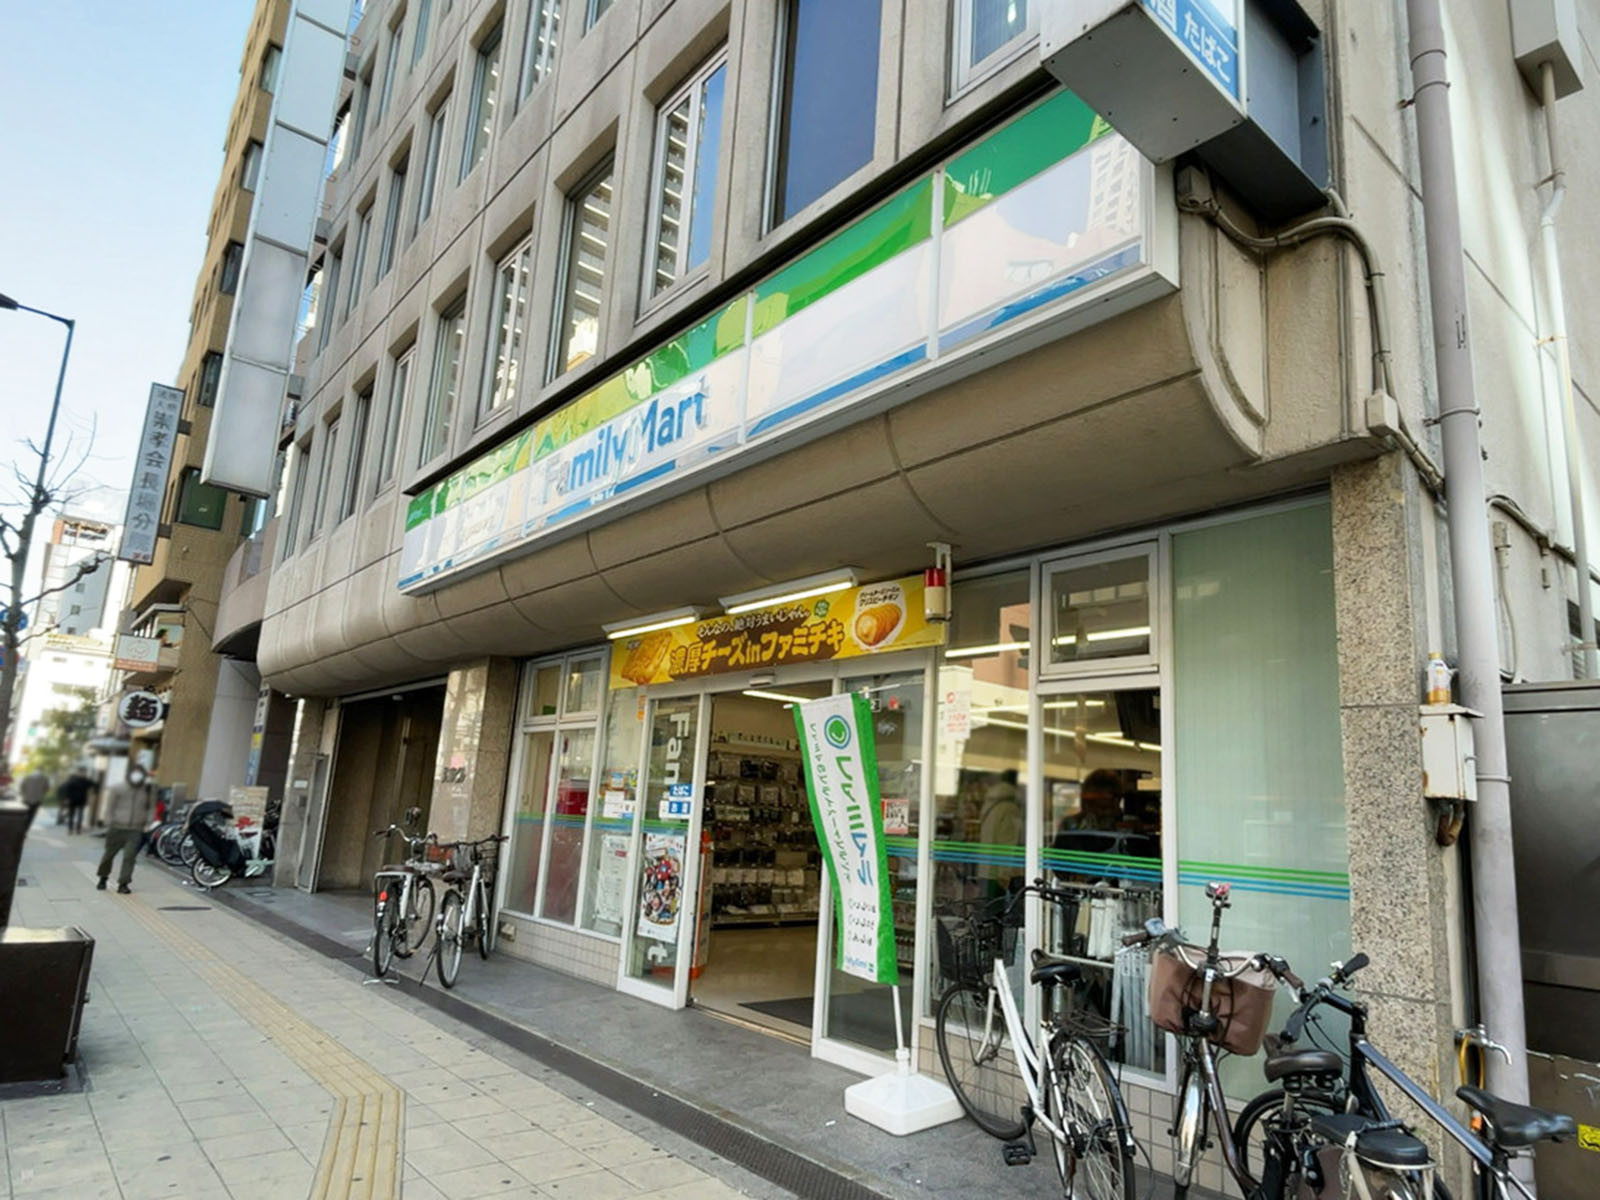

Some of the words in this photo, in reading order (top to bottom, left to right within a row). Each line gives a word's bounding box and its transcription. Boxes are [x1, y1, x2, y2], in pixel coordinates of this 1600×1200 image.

[1183, 11, 1231, 84] たばこ
[543, 376, 711, 504] FamilyMart
[669, 619, 846, 676] 濃厚チーズinファミチキ
